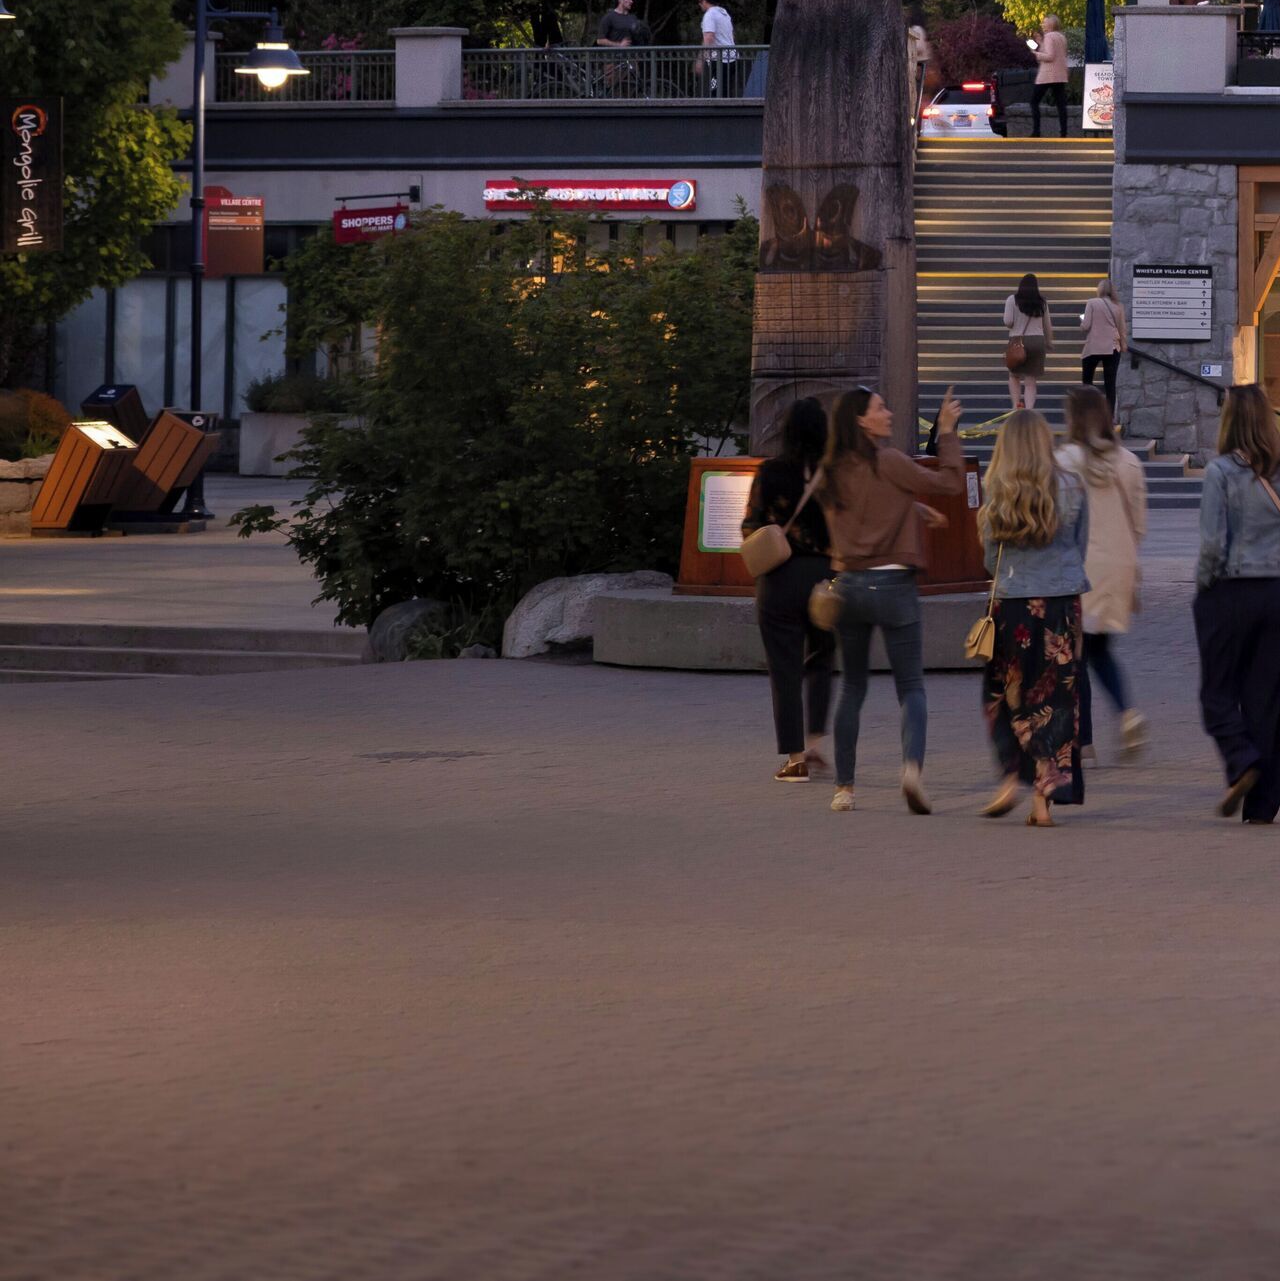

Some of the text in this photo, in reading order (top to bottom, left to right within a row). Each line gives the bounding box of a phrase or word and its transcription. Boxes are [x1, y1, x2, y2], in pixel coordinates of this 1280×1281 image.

[13, 113, 43, 246] Mongolie Grill
[220, 198, 262, 207] VILLAGE CENTRE
[341, 215, 394, 229] SHOPPERS
